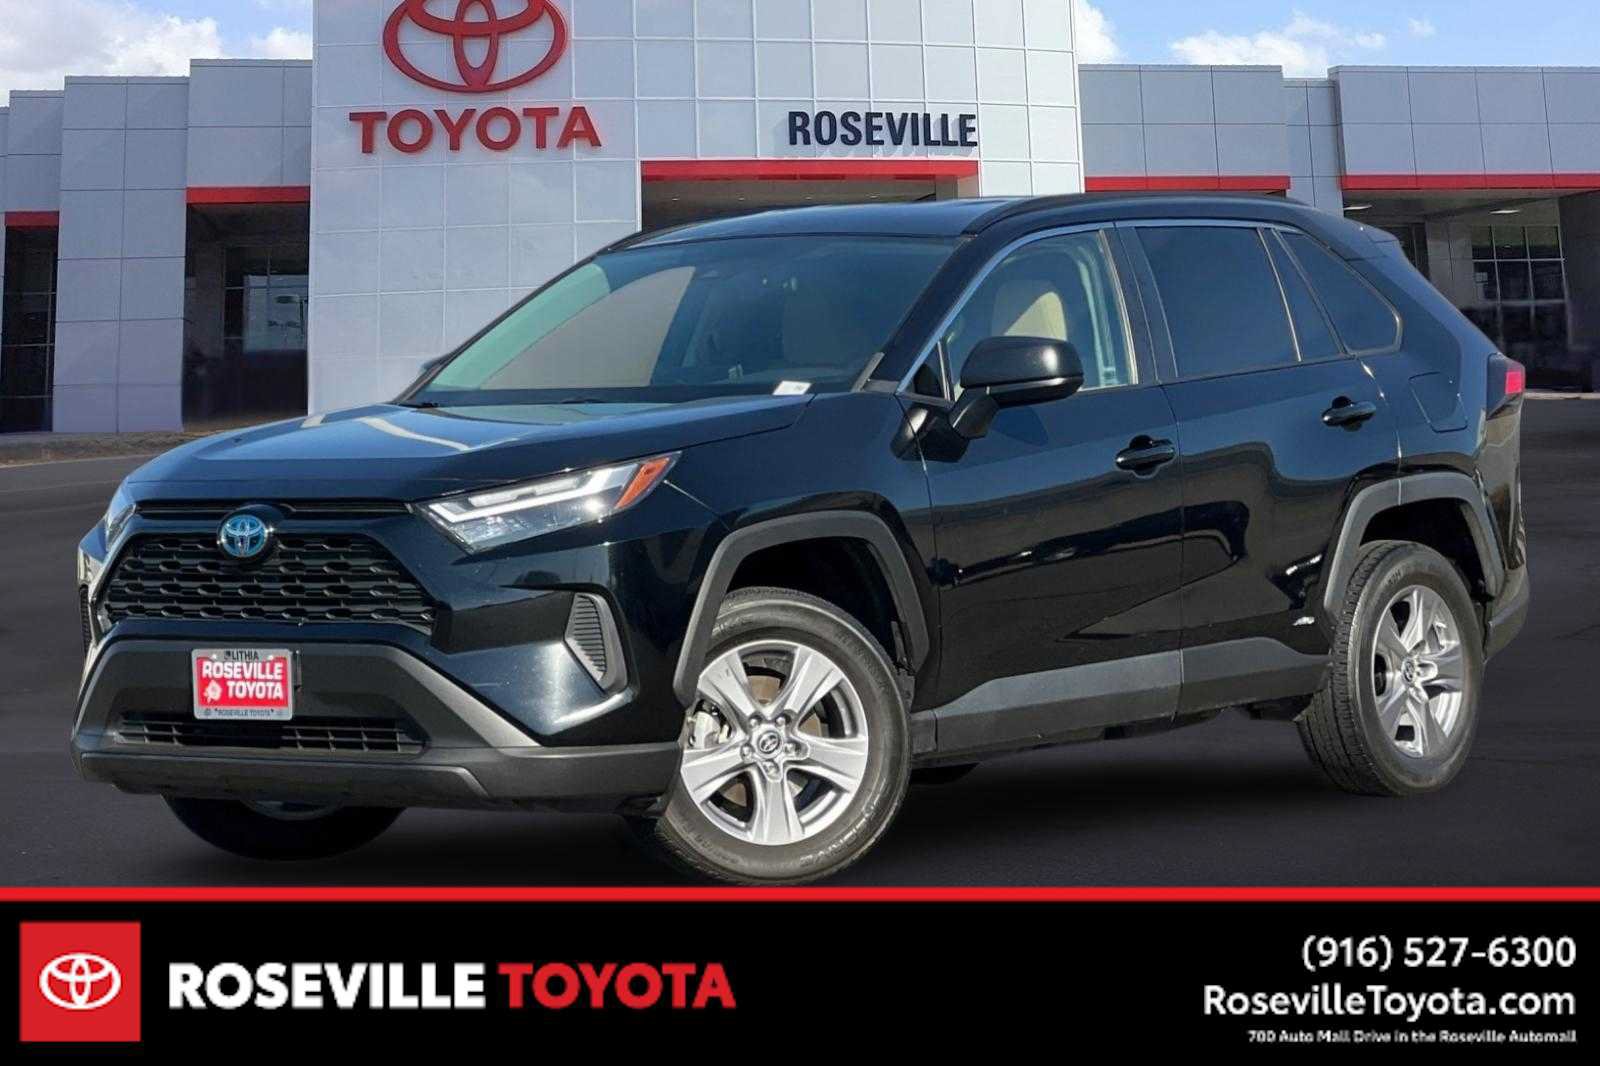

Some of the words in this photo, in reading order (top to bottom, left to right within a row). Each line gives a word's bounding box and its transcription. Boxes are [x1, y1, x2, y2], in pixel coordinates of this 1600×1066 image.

[349, 105, 602, 154] TOYOTA
[788, 110, 978, 148] ROSEVILLE
[202, 660, 284, 680] ROSEVILLE
[226, 680, 284, 699] TOYOTA
